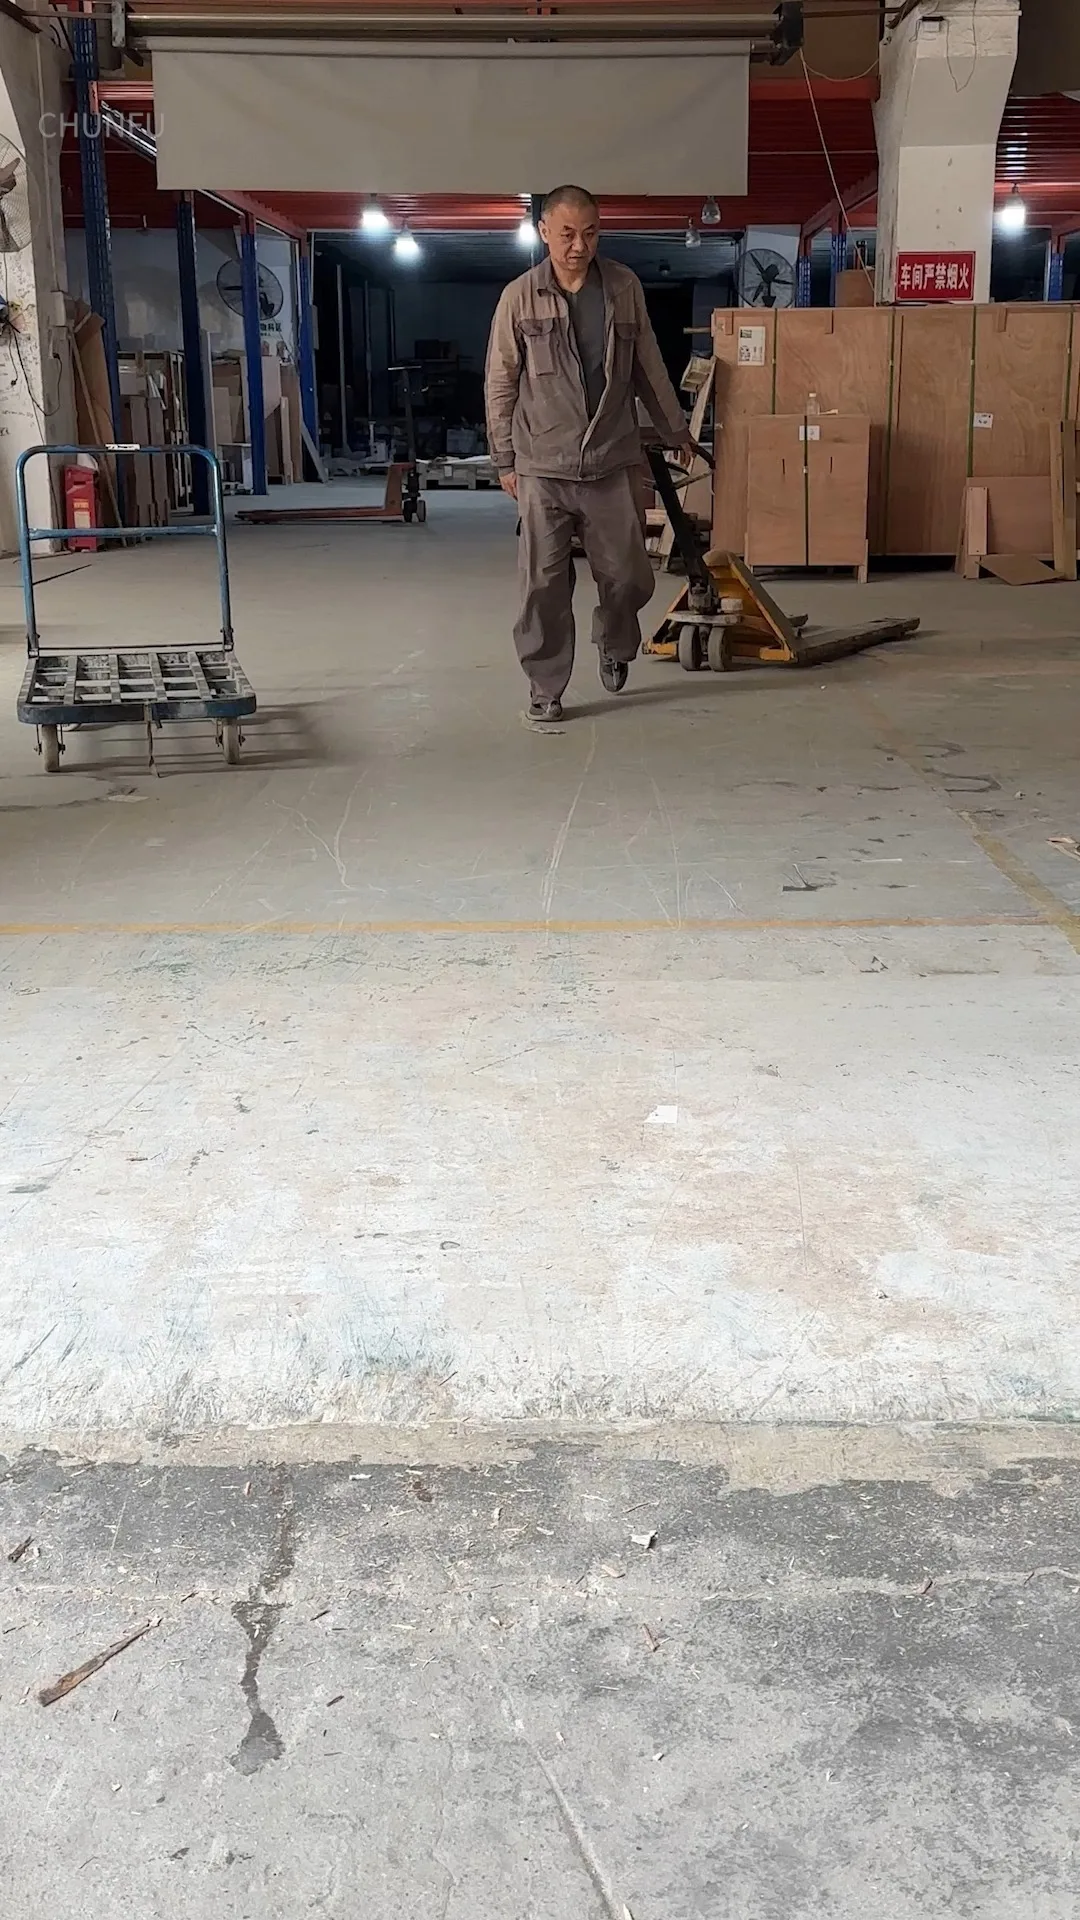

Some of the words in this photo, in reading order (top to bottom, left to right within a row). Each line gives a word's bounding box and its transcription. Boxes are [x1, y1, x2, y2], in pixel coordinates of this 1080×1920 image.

[900, 262, 969, 291] 车间严禁烟火
